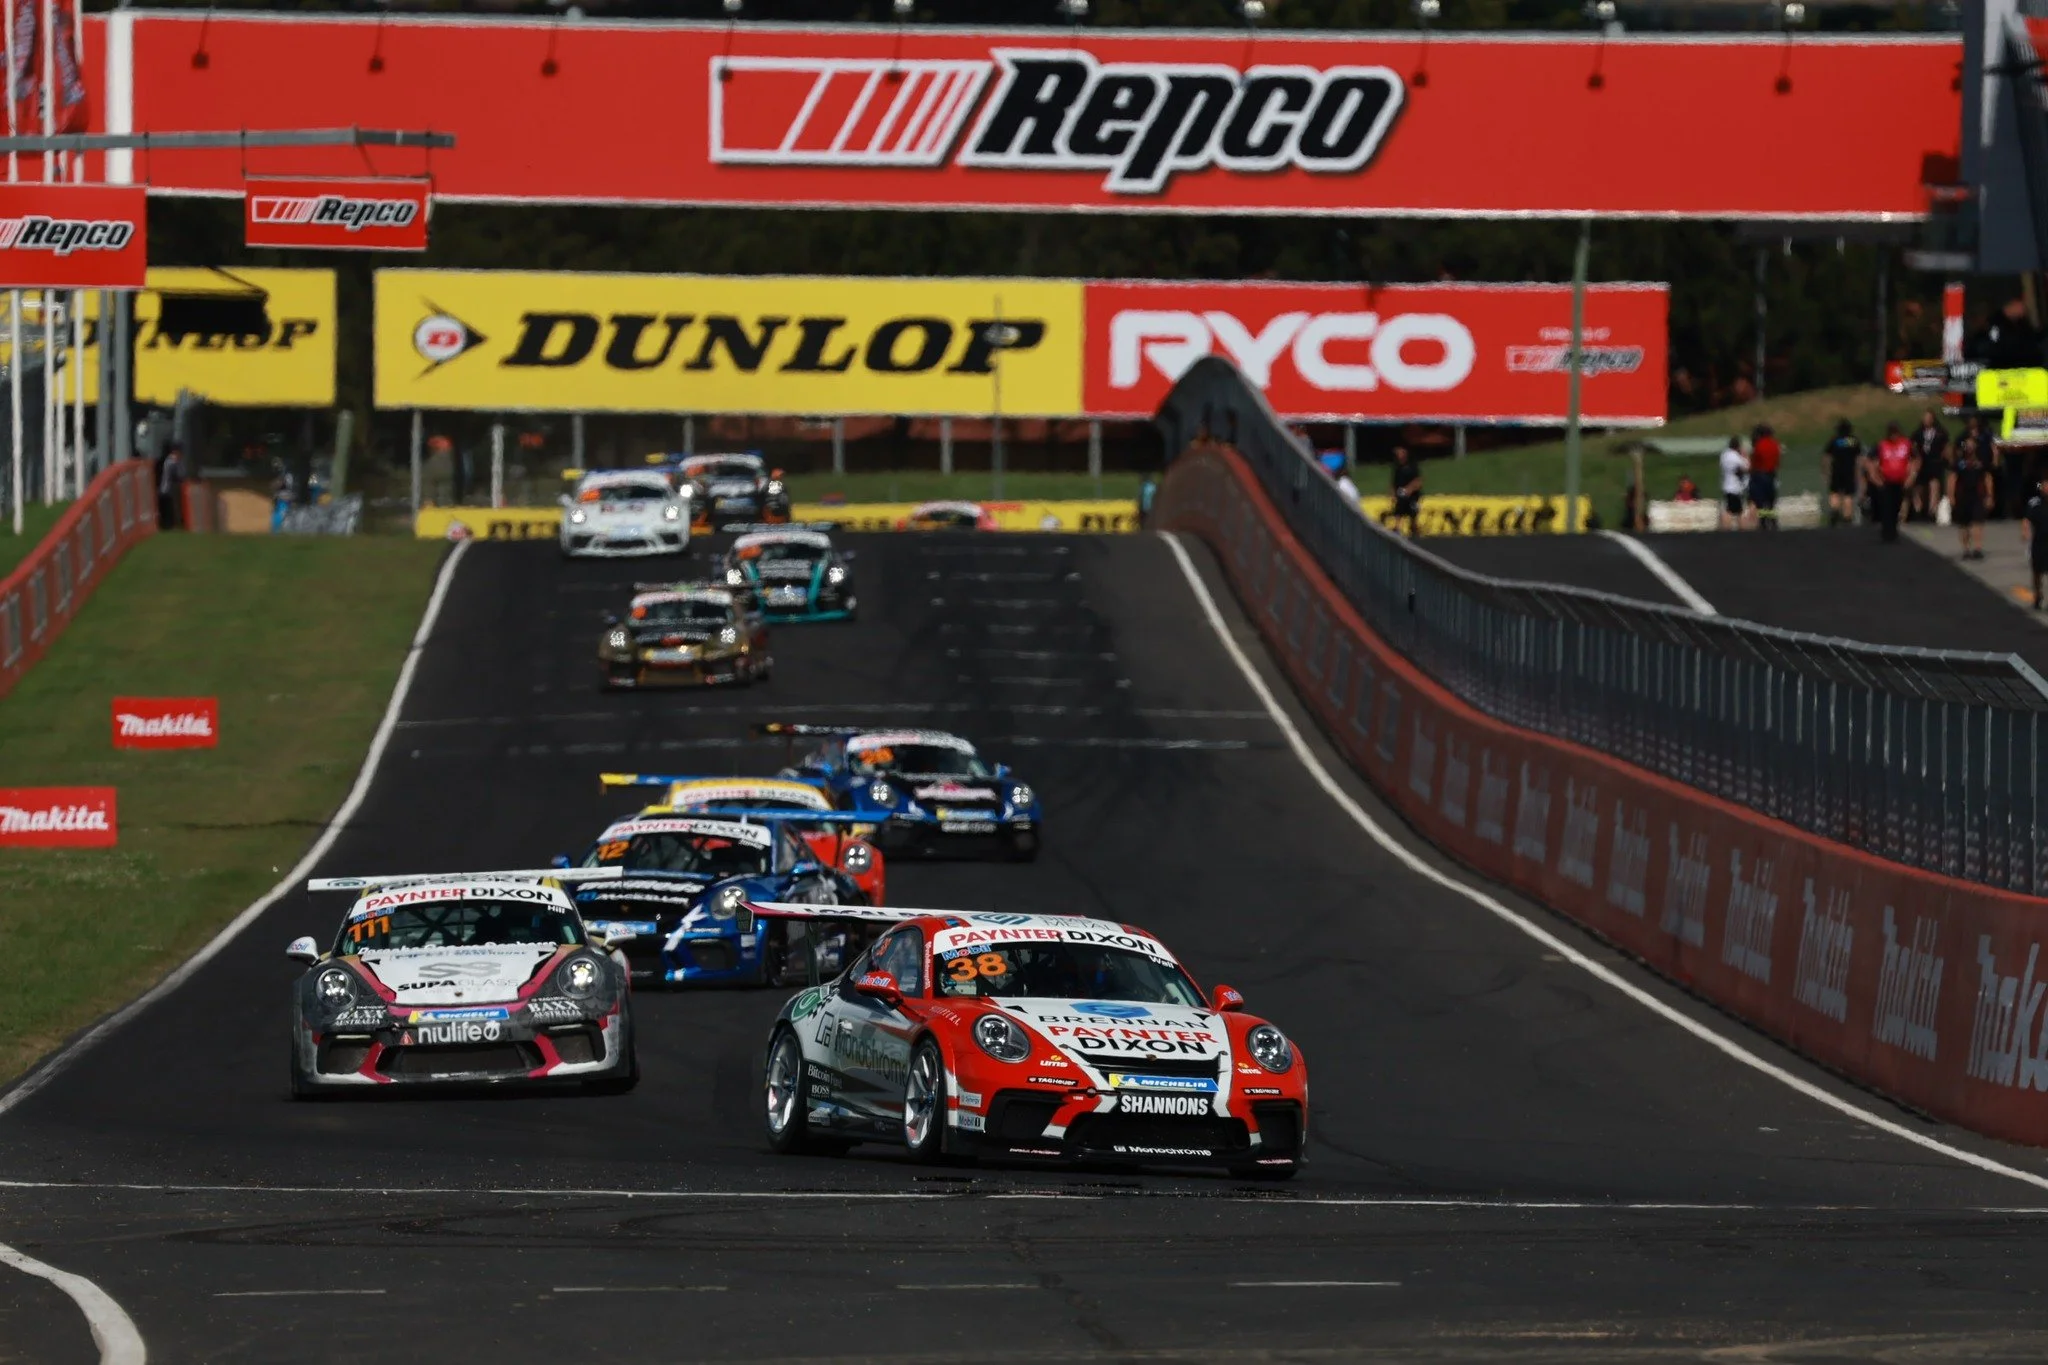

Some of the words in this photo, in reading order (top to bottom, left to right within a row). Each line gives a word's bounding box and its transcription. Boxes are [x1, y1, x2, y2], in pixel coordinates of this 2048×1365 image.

[968, 54, 1399, 185] Repco
[316, 197, 417, 230] Repco
[22, 219, 129, 252] Repco
[499, 311, 1045, 375] DUNLOP
[1110, 310, 1476, 392] RYCO
[116, 713, 212, 736] Makita
[0, 805, 108, 834] Makita
[365, 888, 467, 910] PAYNTER
[471, 887, 553, 902] DIXON
[347, 916, 391, 943] 111
[942, 943, 992, 961] Mobil
[949, 929, 1064, 947] PAYNTER
[1066, 931, 1156, 953] DIXON
[946, 954, 1008, 982] 38
[1148, 955, 1174, 969] Wall
[857, 975, 891, 988] Mobil
[528, 1000, 580, 1013] BAXX
[1038, 1015, 1211, 1029] BRENNAN
[1047, 1026, 1218, 1043] PAYNTER
[1078, 1038, 1208, 1055] DIXON
[811, 1084, 830, 1095] BOSS
[1140, 1078, 1208, 1088] MICHELIN
[1121, 1095, 1209, 1116] SHANNONS
[1129, 1145, 1212, 1157] Monochrome
